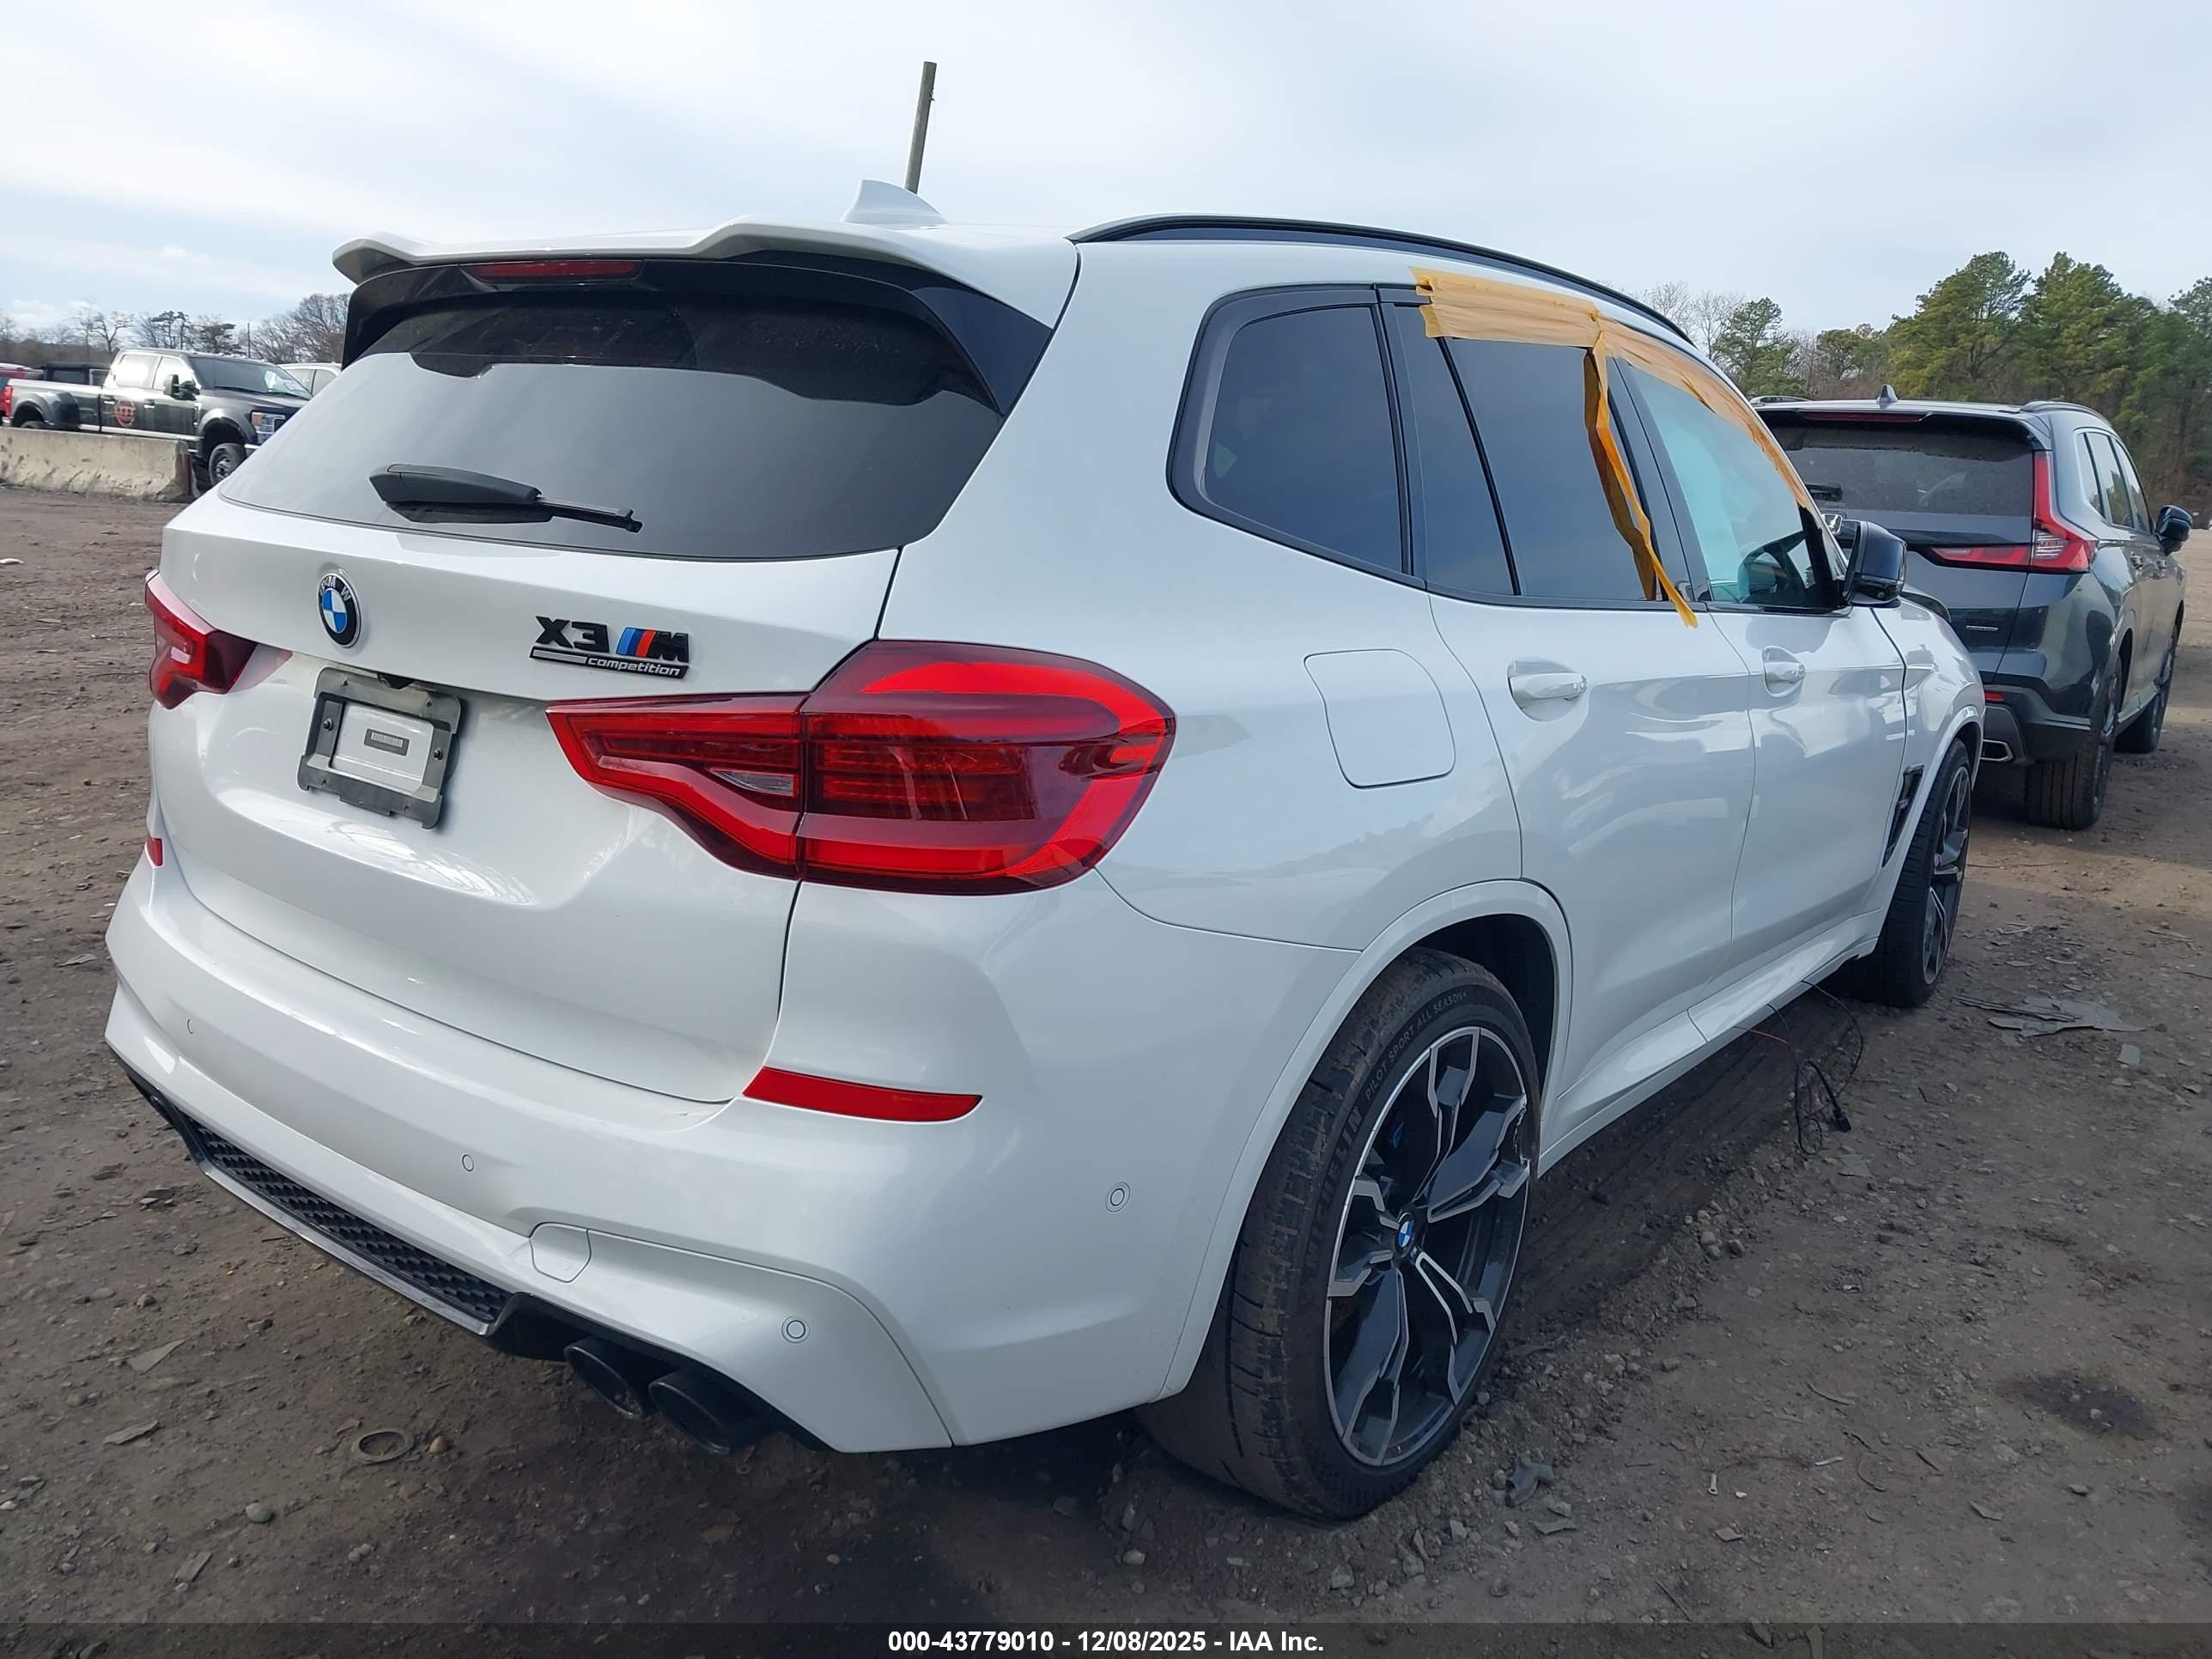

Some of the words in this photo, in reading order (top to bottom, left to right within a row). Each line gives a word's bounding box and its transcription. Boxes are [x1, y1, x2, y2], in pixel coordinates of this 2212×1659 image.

[535, 616, 610, 653] X3
[641, 630, 690, 663] M
[586, 656, 681, 677] competition
[1364, 1060, 1388, 1101] PILOT
[1388, 1024, 1415, 1062] SPORT
[1416, 1009, 1432, 1031] ALL
